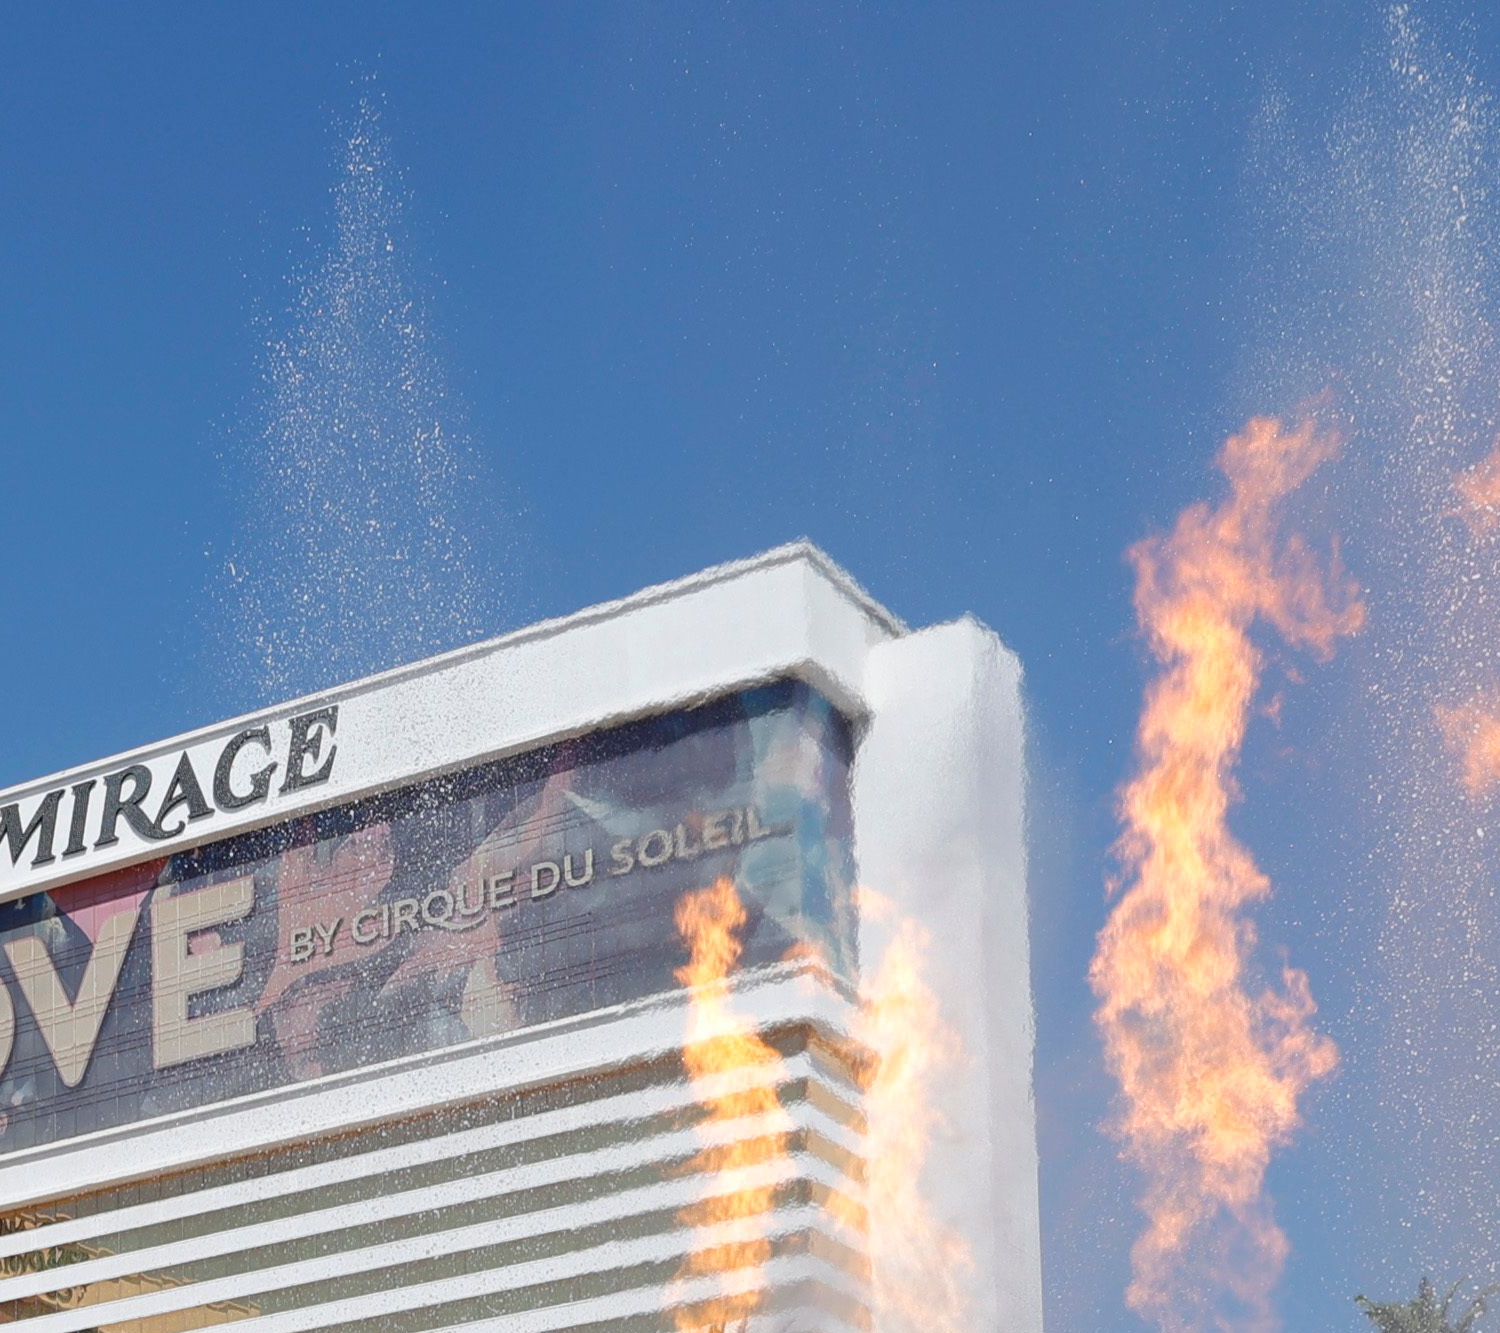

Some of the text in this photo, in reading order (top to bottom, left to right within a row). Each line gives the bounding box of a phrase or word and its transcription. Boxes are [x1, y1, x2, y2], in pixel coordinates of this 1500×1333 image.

[290, 806, 773, 962] BY CIRQUE DU SOLEIL
